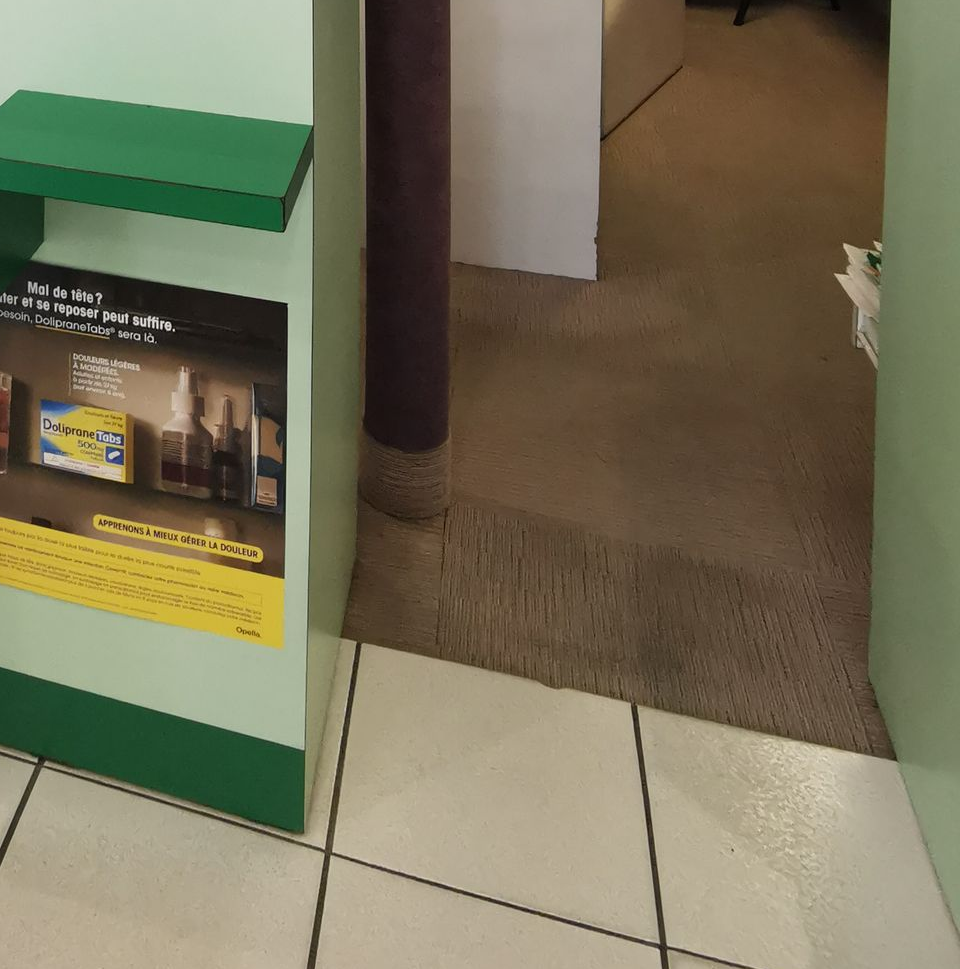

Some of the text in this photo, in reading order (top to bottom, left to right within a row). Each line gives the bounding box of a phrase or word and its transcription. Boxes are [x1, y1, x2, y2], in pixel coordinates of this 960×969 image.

[27, 281, 50, 297] Mal
[53, 285, 68, 300] de
[22, 296, 34, 309] et
[36, 299, 50, 312] se
[54, 301, 99, 320] reposer
[102, 309, 130, 325] peut
[132, 314, 176, 332] suffire.
[117, 329, 141, 341] sera
[143, 332, 158, 344] là.
[73, 352, 141, 372] DOULEURS LÉGÈRES
[73, 362, 79, 370] À
[43, 418, 122, 445] Doliprane Tabs
[77, 440, 97, 450] 500
[98, 518, 258, 559] APPRENONS À MIEUX GÉRER LA DOULEUR
